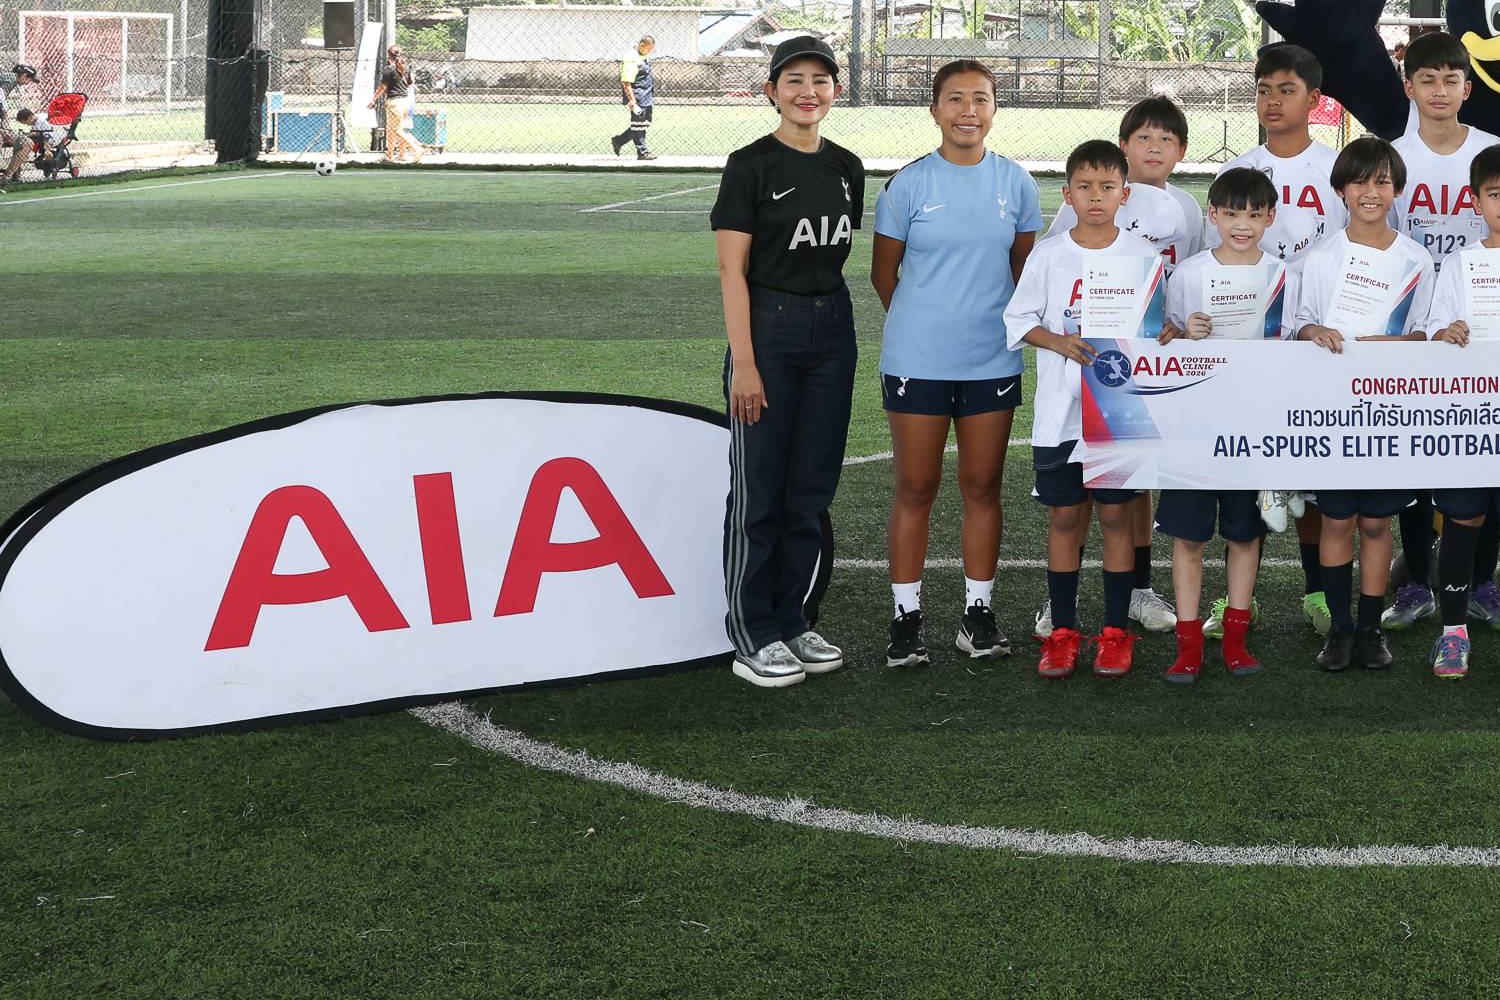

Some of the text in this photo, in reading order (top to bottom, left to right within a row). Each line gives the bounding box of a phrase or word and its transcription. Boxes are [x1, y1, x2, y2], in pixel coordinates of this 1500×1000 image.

[1283, 184, 1326, 216] IA
[1408, 183, 1482, 216] AIA
[788, 214, 852, 250] AIA
[1294, 238, 1309, 252] AIA
[1423, 233, 1467, 255] P123
[1345, 272, 1391, 291] CERTIFICATE
[1210, 293, 1257, 302] CERTIFICATE
[1132, 356, 1228, 377] AIA FOOTBALL
[1213, 435, 1331, 458] AIA-SPURS
[1342, 435, 1399, 457] ELITE
[203, 456, 676, 651] AIA
